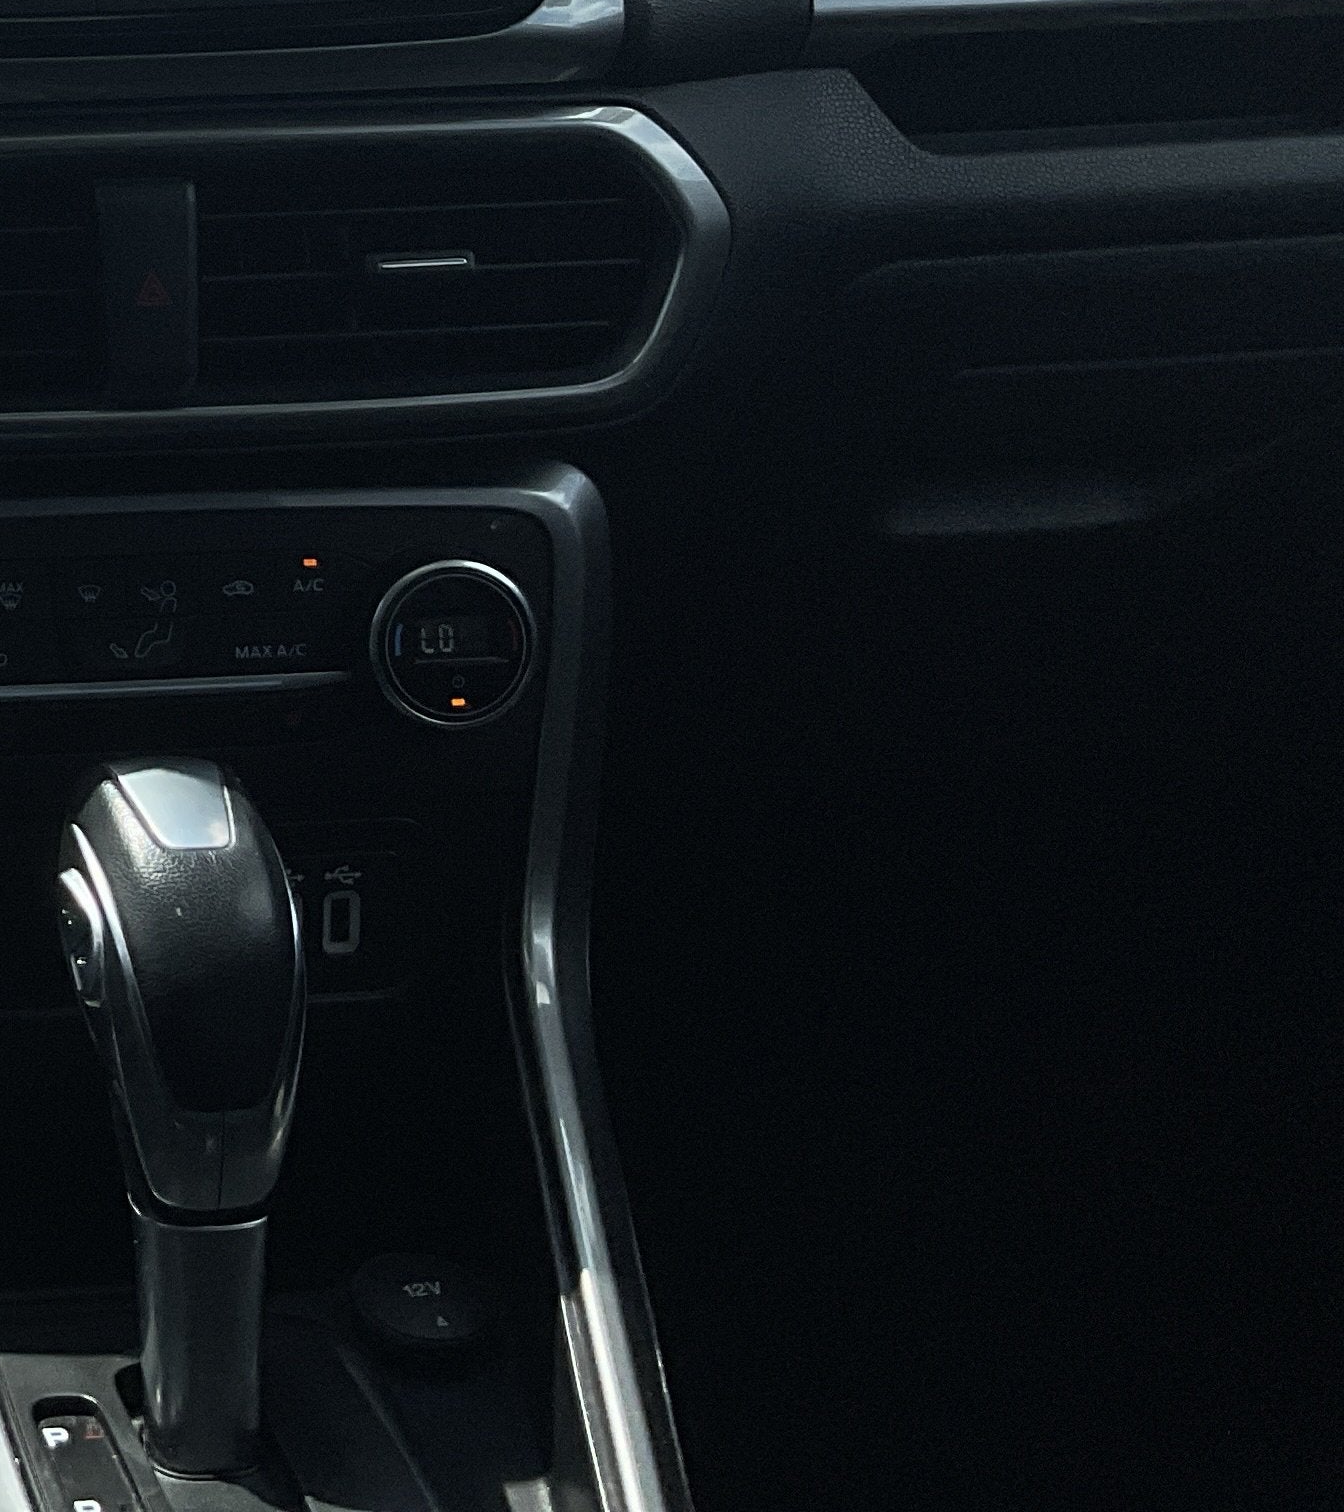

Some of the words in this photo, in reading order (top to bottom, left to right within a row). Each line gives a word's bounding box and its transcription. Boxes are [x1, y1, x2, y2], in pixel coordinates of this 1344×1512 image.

[293, 578, 324, 592] A/C
[235, 645, 272, 659] MAX
[277, 643, 308, 657] A/C
